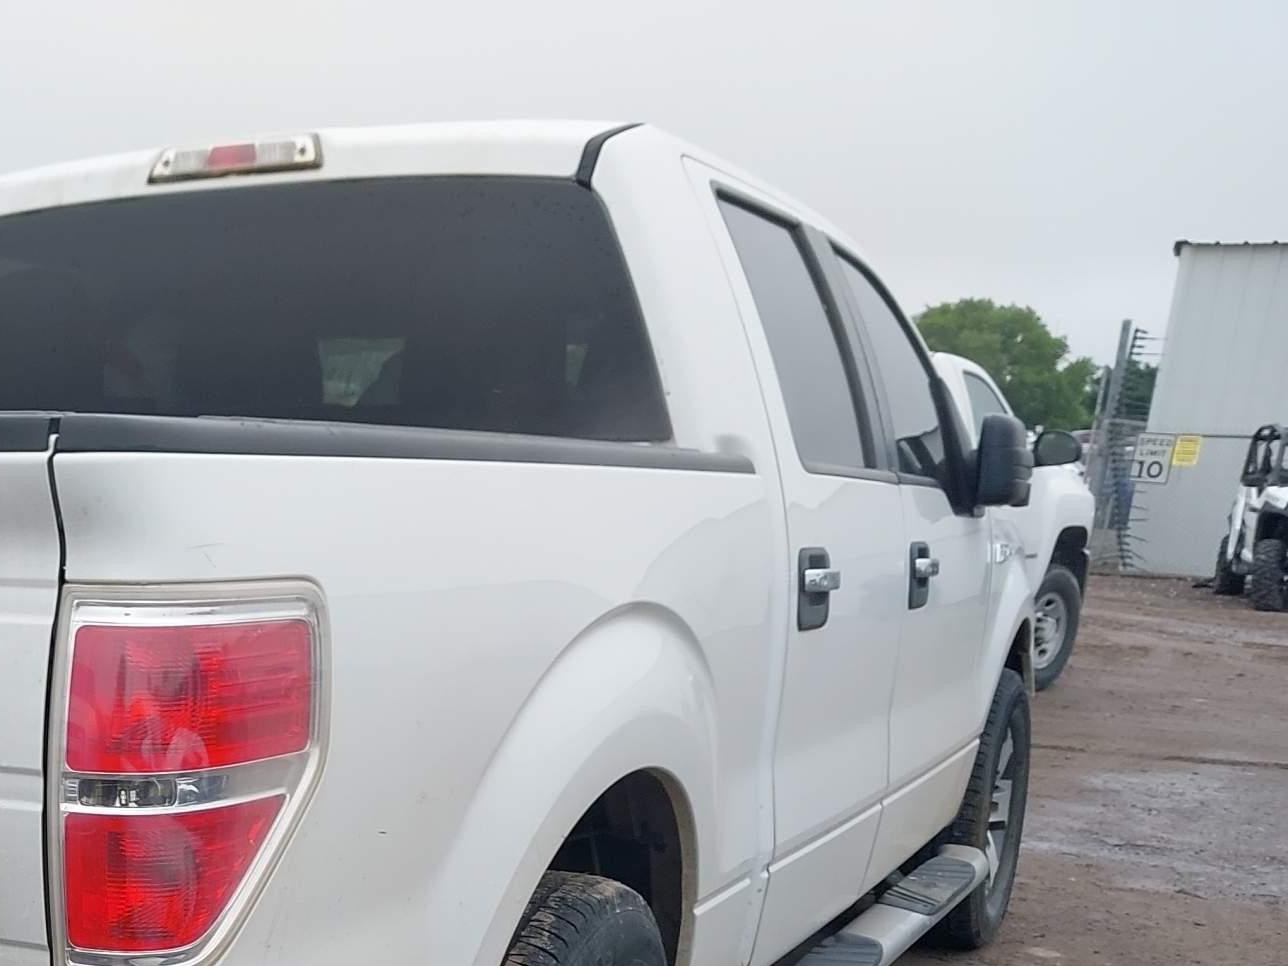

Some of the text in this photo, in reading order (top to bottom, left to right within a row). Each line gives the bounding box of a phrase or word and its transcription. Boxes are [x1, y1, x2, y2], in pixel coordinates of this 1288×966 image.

[1140, 437, 1173, 446] SPEED
[1139, 449, 1167, 457] LIMIT
[1136, 460, 1164, 479] 10
